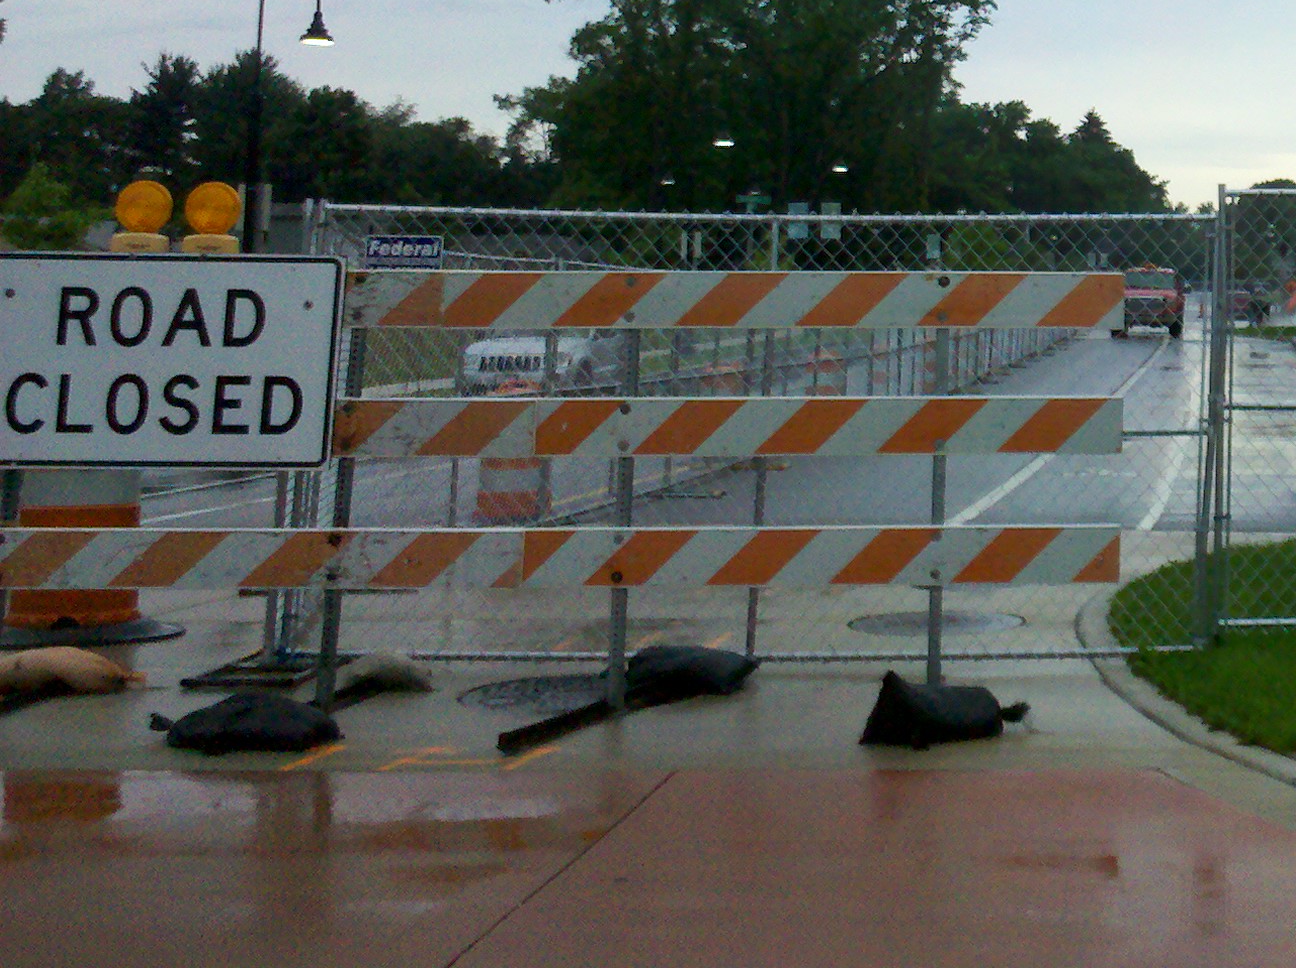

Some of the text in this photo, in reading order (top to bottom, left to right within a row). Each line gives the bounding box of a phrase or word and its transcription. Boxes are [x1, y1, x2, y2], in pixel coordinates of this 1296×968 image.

[368, 240, 440, 257] Federal
[56, 286, 266, 347] ROAD
[6, 372, 303, 435] CLOSED
